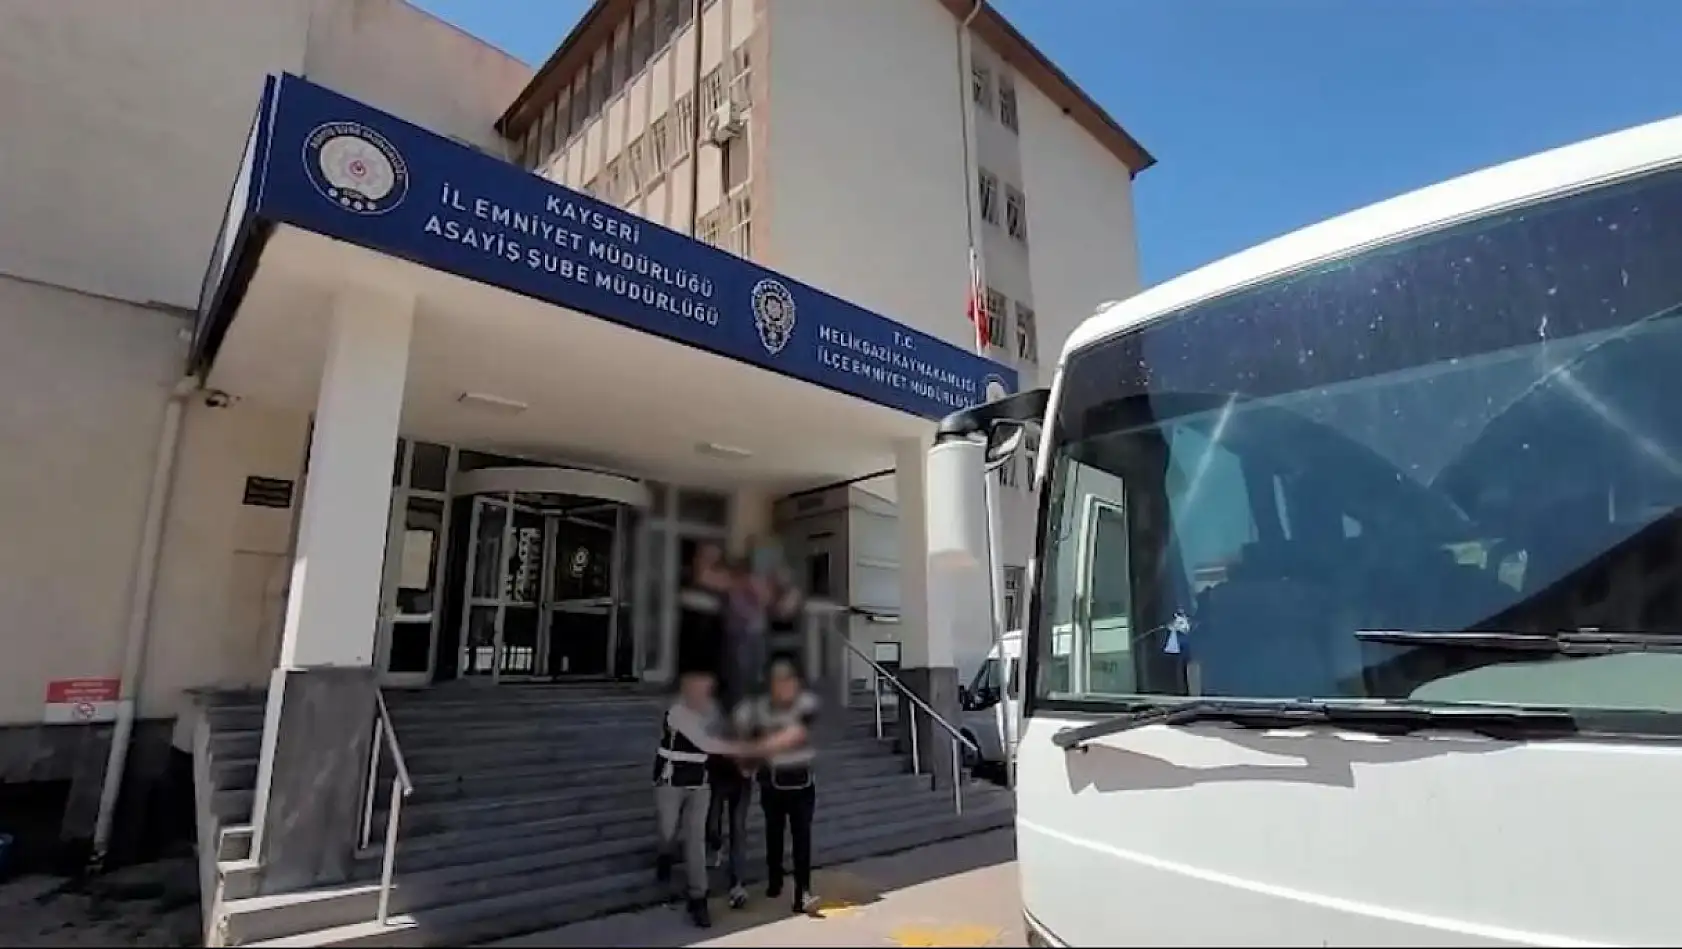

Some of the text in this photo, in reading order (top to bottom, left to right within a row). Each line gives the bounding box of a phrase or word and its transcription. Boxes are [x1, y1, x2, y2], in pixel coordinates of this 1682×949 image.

[424, 216, 719, 327] ASAYİŞ ŞUBE MÜDÜRLÜĞÜ
[441, 183, 714, 298] İL EMNİYET MÜDÜRLÜĞÜ
[546, 195, 640, 244] KAYSERİ
